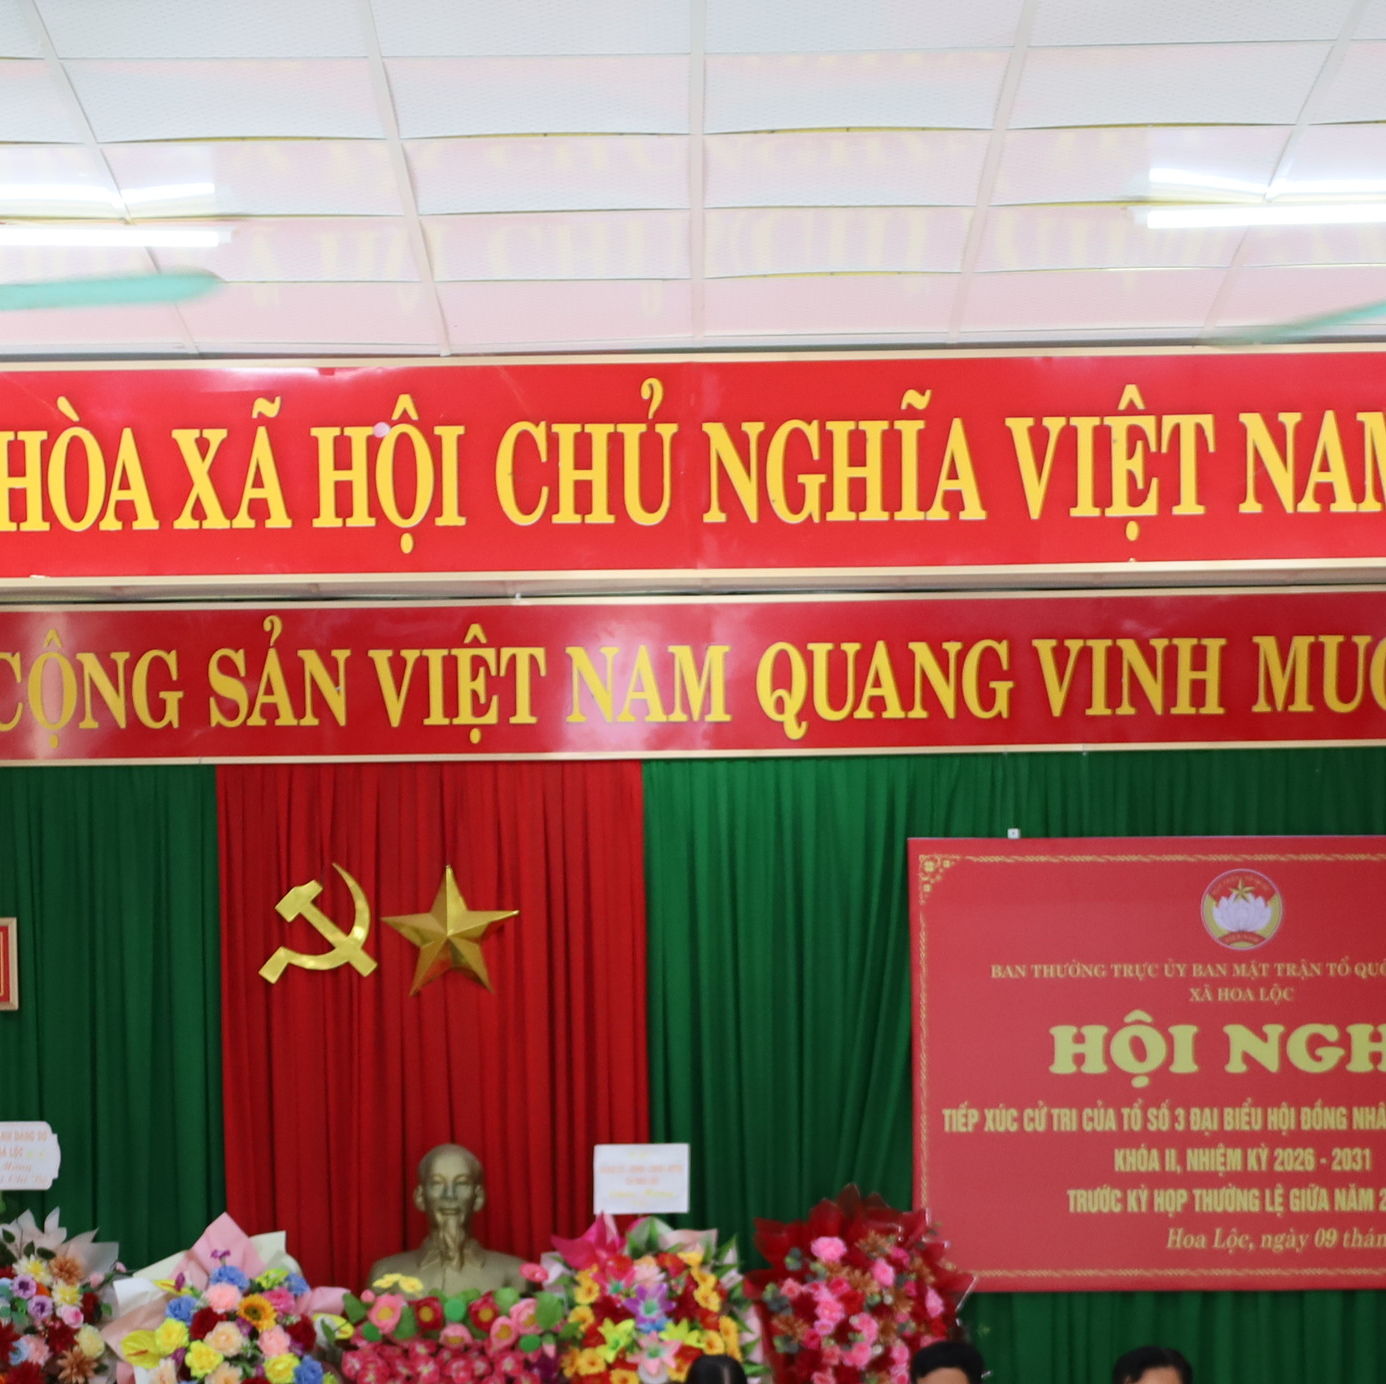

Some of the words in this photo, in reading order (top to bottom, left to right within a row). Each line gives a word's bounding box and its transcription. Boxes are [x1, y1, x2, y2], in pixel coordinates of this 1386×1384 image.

[171, 396, 292, 530] XÃ
[311, 394, 466, 554] HỘI
[496, 378, 679, 526] CHỦ
[702, 389, 987, 524] NGHĨA
[1005, 384, 1215, 541] VIỆT
[208, 615, 351, 728] SẢN
[368, 624, 547, 744] VIỆT
[566, 640, 732, 732] NAM
[756, 639, 1014, 740] QUANG
[1032, 638, 1227, 717] VINH
[1189, 984, 1213, 1002] XÃ
[1218, 988, 1255, 1002] HOA
[1259, 983, 1294, 1005] LỘC
[1049, 1009, 1199, 1088] HỘI
[942, 1101, 980, 1133] TIẾP
[984, 1104, 1019, 1132] XÚC
[1023, 1100, 1049, 1132] CỬ
[1050, 1108, 1078, 1131] TRI
[1082, 1100, 1118, 1132] CỦA
[1121, 1098, 1143, 1132] TỔ
[1147, 1099, 1171, 1131] SỐ
[1174, 1107, 1186, 1131] 3
[1189, 1107, 1219, 1136] ĐẠI
[1223, 1097, 1263, 1131] BIỂU
[1267, 1102, 1296, 1136] HỘI
[1114, 1144, 1161, 1172] KHÓA
[1165, 1148, 1182, 1174] II,
[1186, 1143, 1243, 1176] NHIỆM
[1247, 1143, 1269, 1171] KỲ
[1274, 1148, 1315, 1171] 2026
[1331, 1147, 1371, 1171] 2031
[1067, 1184, 1123, 1213] TRƯỚC
[1127, 1184, 1149, 1213] KỲ
[1153, 1188, 1189, 1217] HỌP
[1192, 1183, 1261, 1213] THƯỜNG
[1265, 1184, 1285, 1217] LỆ
[1289, 1184, 1330, 1212] GIỮA
[1334, 1184, 1375, 1212] NĂM
[1167, 1227, 1208, 1249] Hoa
[1212, 1227, 1255, 1254] Lộc,
[1260, 1228, 1310, 1253] ngày
[1314, 1228, 1339, 1248] 09
